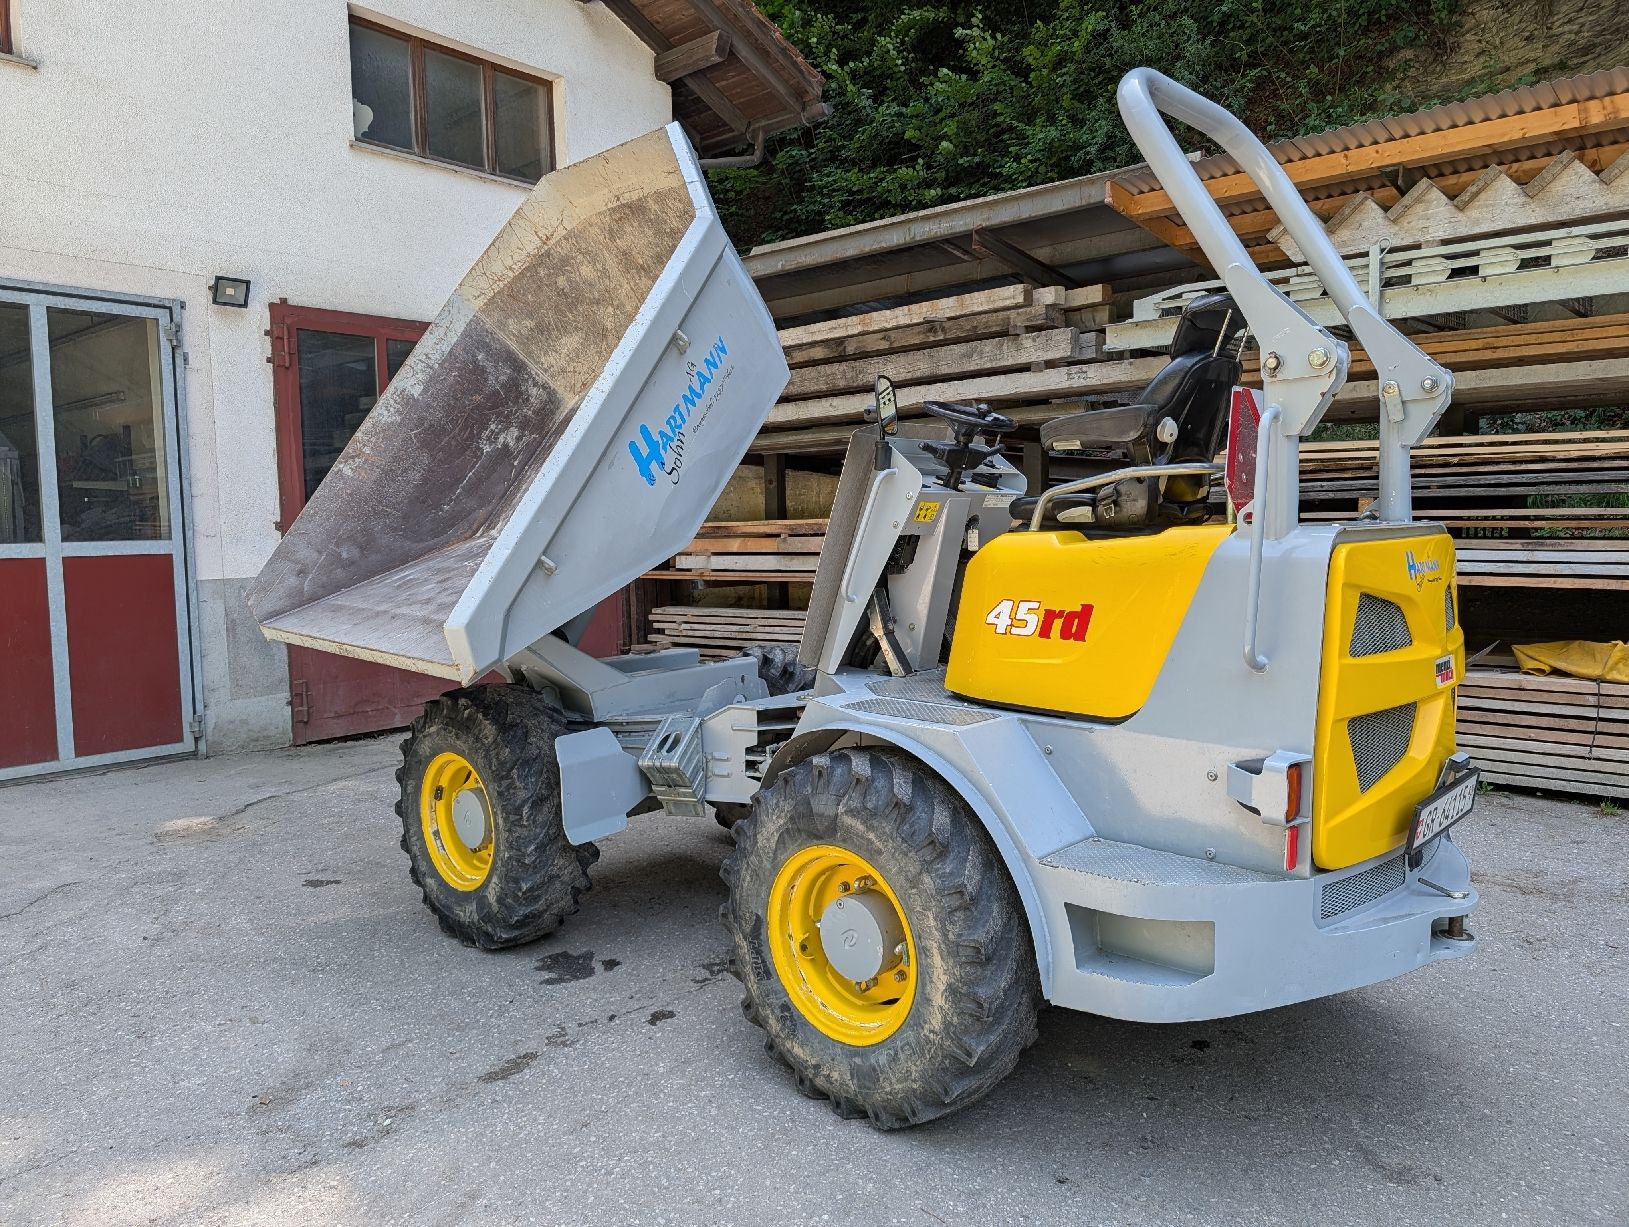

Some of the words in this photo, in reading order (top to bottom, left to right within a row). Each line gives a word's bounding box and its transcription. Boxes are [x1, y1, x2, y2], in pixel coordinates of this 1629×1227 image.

[628, 336, 729, 486] HARTMANN
[664, 432, 686, 485] Sohn
[985, 598, 1095, 642] 45rd
